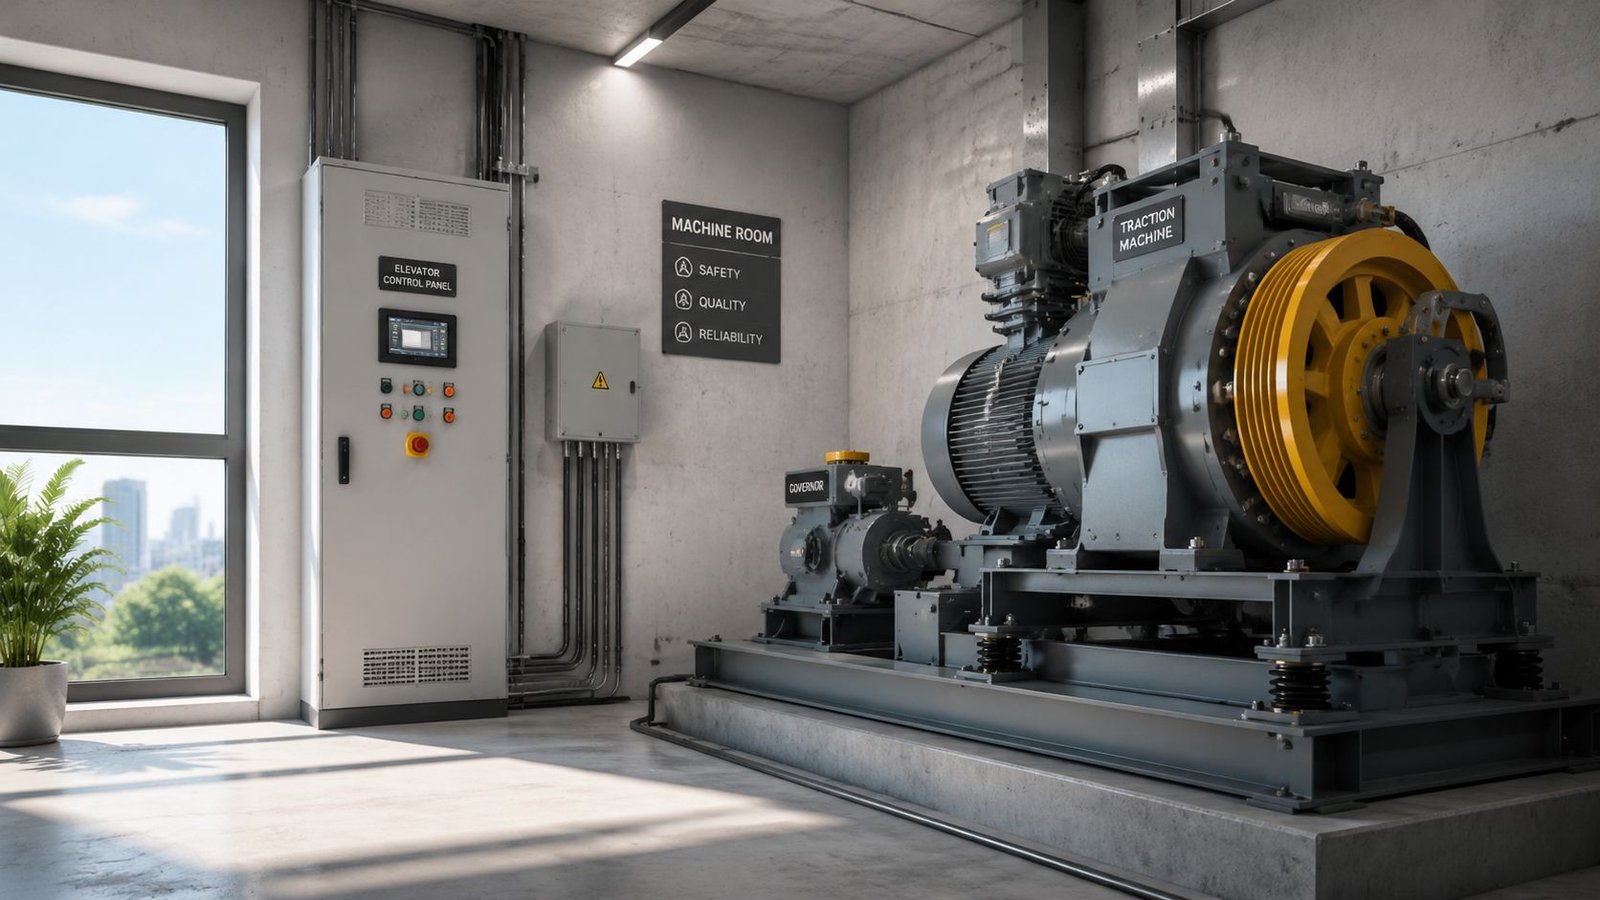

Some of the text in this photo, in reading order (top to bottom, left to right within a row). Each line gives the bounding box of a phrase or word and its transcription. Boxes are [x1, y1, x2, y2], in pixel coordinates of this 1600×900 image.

[1120, 206, 1175, 233] TRACTION
[671, 216, 773, 245] MACHINE ROOM
[1119, 225, 1173, 252] MACHINE
[394, 264, 440, 277] ELEVATOR
[699, 264, 741, 280] SAFETY
[383, 275, 452, 291] CONTROL PANEL
[699, 296, 746, 311] QUALITY
[699, 328, 763, 345] RELIABILITY
